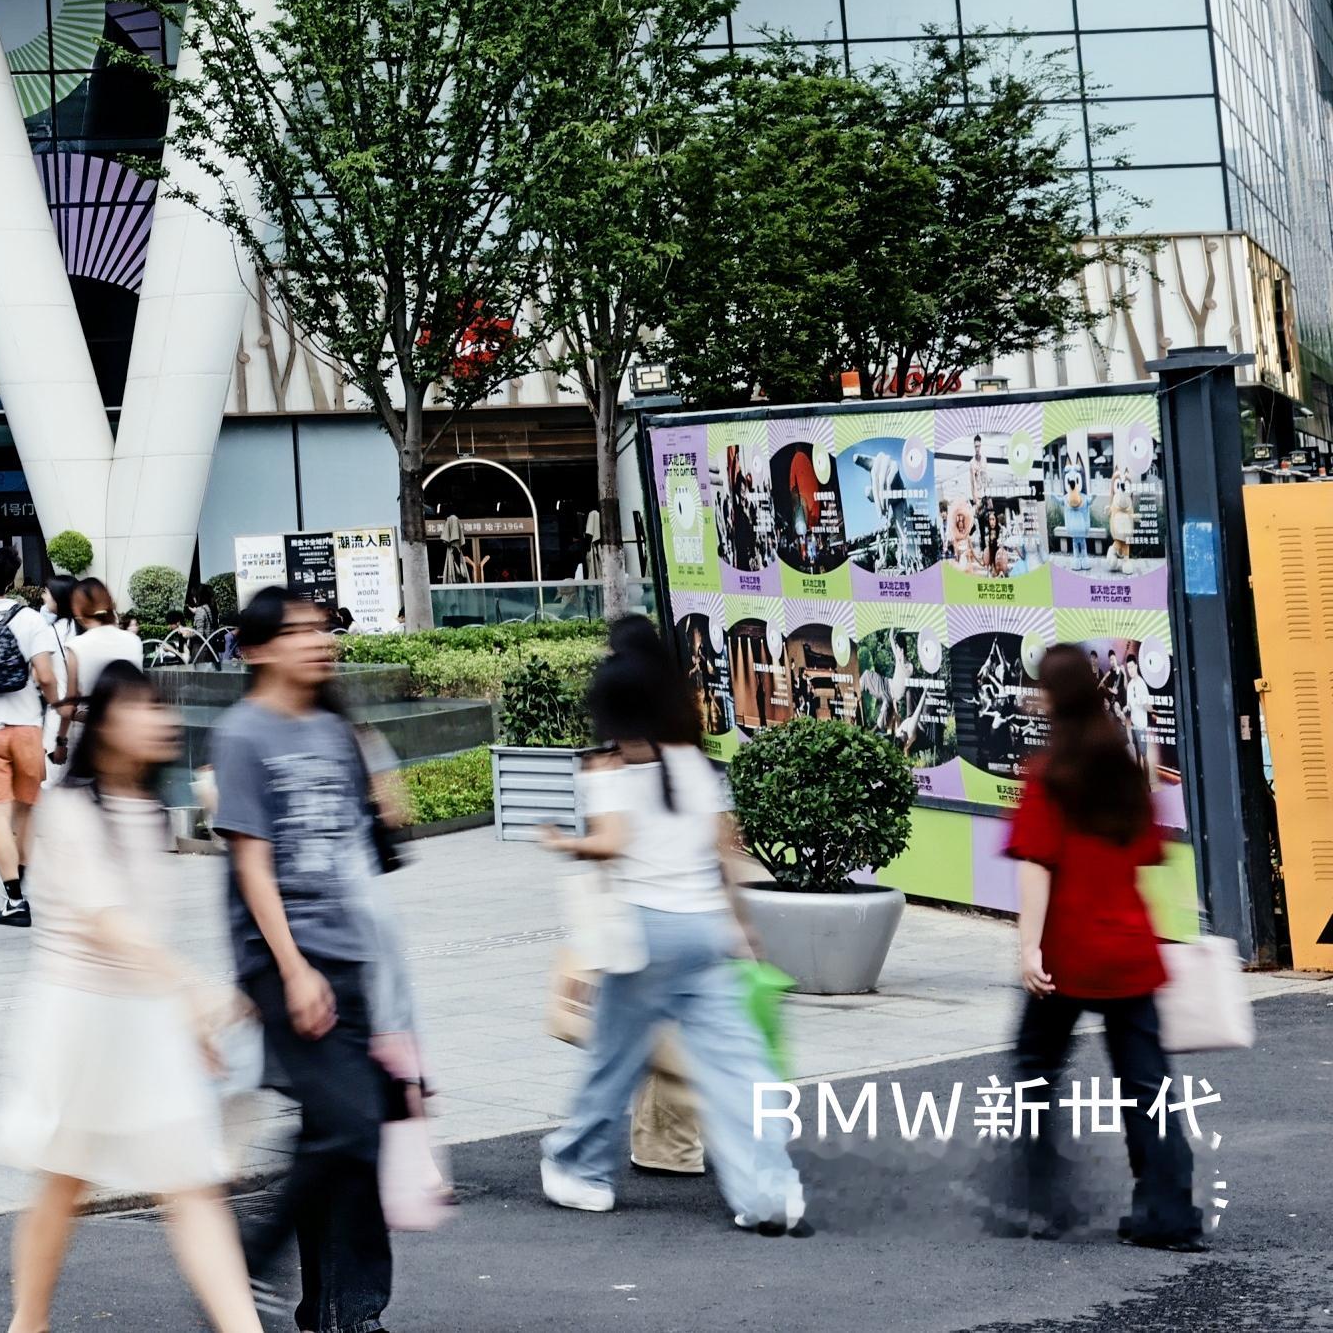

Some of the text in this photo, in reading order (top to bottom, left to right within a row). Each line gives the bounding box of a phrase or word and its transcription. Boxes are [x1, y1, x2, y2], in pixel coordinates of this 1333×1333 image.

[0, 502, 35, 517] 1号门
[427, 522, 524, 532] 北美咖啡 始于1964
[337, 534, 391, 549] 潮流入局
